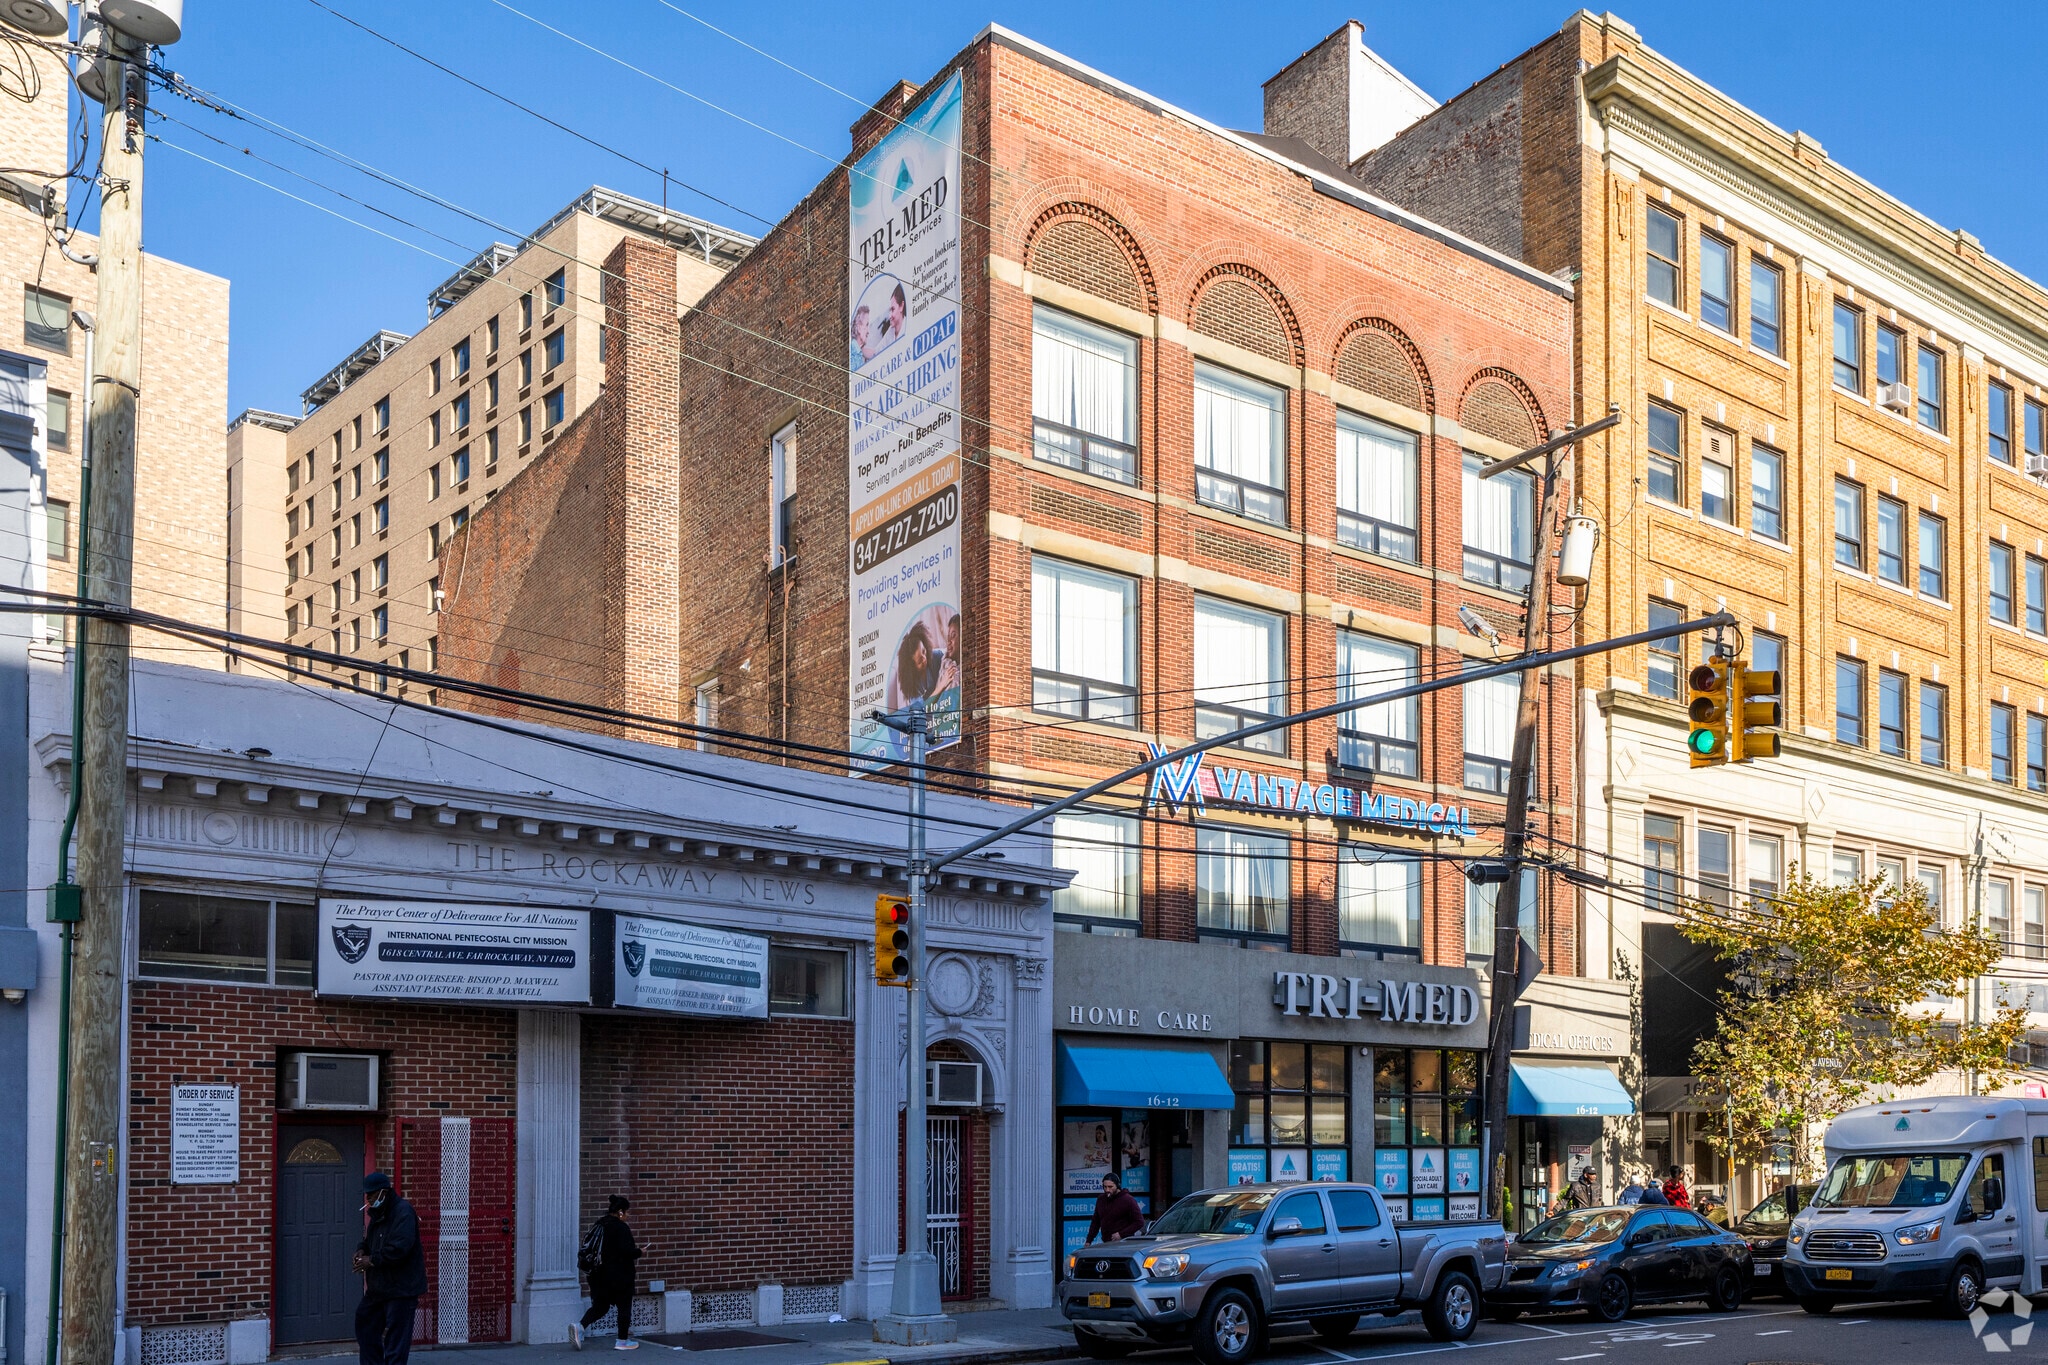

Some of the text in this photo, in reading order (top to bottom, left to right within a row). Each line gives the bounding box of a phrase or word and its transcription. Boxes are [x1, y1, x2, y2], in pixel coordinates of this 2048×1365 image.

[859, 175, 948, 271] TRI-MED
[864, 214, 942, 284] Home Care Services
[913, 238, 956, 276] Are you looking
[912, 258, 948, 292] for homecare
[912, 284, 933, 303] services
[934, 275, 943, 288] for
[912, 275, 957, 318] family member?
[854, 314, 955, 399] HOME CARE & CDPAP
[853, 345, 957, 433] WE ARE HIRING
[910, 401, 925, 420] ALL
[926, 382, 953, 411] AREAS!
[857, 411, 952, 478] Top Pay Full Benefits
[865, 438, 944, 494] Serving in all languages
[855, 460, 955, 534] APPLY ON-LINE OR CALL TODAY
[856, 491, 955, 571] 347-727-7200
[858, 545, 953, 605] Providing Services in
[867, 570, 941, 620] all of New York!
[858, 629, 880, 647] BROOKLYN
[861, 646, 876, 662] BRONX
[860, 661, 877, 677] QUEENS
[855, 672, 885, 695] NEW YORK CITY
[854, 689, 884, 710] STATEN ISLAND
[940, 696, 952, 712] get
[942, 711, 959, 727] care
[860, 723, 878, 738] SUFFOLK
[1213, 766, 1477, 837] VANTAGE MEDICAL
[447, 842, 815, 905] THE ROCKAWAY NEWS
[336, 904, 578, 926] The Prayer Center of Deliverance For All Nations
[388, 931, 567, 945] INTERNATIONAL PENTECOSTAL CITY MISSION
[625, 921, 637, 932] The
[637, 923, 658, 938] Prayer
[660, 926, 680, 938] Center
[680, 930, 689, 941] of
[688, 930, 721, 944] Deliverance
[721, 936, 732, 945] For
[381, 948, 402, 957] 1618
[403, 949, 443, 958] CENTRAL
[465, 951, 485, 960] FAR
[536, 954, 549, 963] NY
[549, 955, 574, 964] 11691
[655, 948, 757, 968] INTERNATIONAL PENTECOSTAL CITY MISSION
[353, 972, 559, 986] PASTOR AND OVERSEER: BISHOP D. MAXWELL
[372, 984, 542, 996] ASSISTANT PASTOR: REV. B. MAXWELL
[634, 985, 658, 994] PASTOR
[659, 987, 671, 996] AND
[1273, 971, 1480, 1026] TRI-MED
[646, 996, 676, 1007] ASSISTANT
[717, 1003, 743, 1013] MAXWELL
[1068, 1004, 1213, 1032] HOME CARE
[1567, 1033, 1614, 1051] OFFICES
[178, 1089, 234, 1099] ORDER OF SERVICE
[1147, 1094, 1180, 1107] 16-12
[1576, 1104, 1599, 1115] 16-12
[1383, 1153, 1398, 1162] FREE
[1453, 1161, 1472, 1169] MEALS!
[1231, 1163, 1261, 1172] GRATIS!
[1317, 1163, 1340, 1172] GRATIS!
[1065, 1204, 1088, 1213] OTHER
[1394, 1205, 1403, 1213] US
[1415, 1205, 1440, 1213] CALL US!
[1449, 1212, 1477, 1220] WELCOME!
